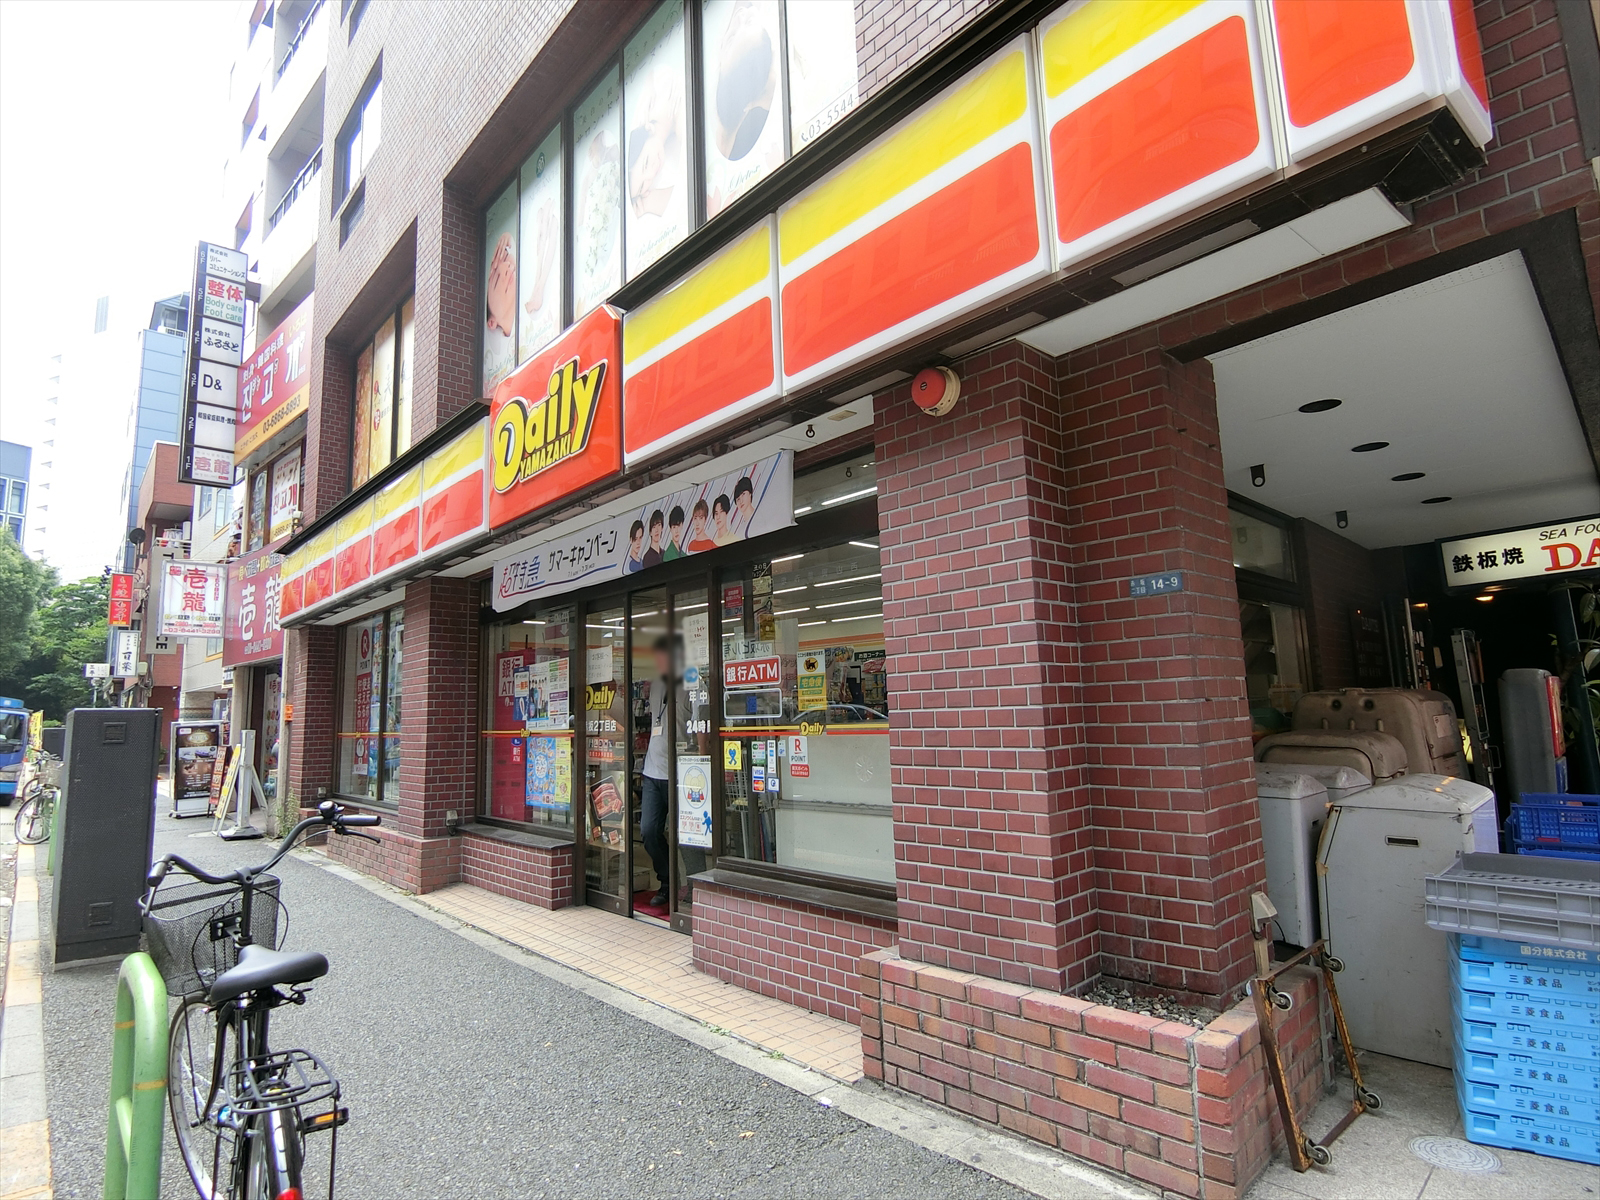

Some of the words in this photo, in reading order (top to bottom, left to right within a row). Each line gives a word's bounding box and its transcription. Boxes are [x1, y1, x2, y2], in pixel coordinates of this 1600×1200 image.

[207, 279, 244, 303] 整体
[205, 296, 225, 309] Body
[226, 303, 243, 314] care
[205, 306, 223, 318] Foot
[225, 312, 243, 323] care
[204, 336, 239, 353] ふるさと
[191, 373, 197, 387] 3F
[203, 373, 222, 391] D&
[188, 416, 195, 431] 2F
[494, 358, 607, 493] Daily
[186, 456, 191, 470] 1F
[520, 432, 573, 481] YAMAZAKI
[1538, 527, 1567, 541] SEA
[549, 530, 619, 572] サマーキャンペーン
[1452, 547, 1525, 573] 鉄板焼
[1151, 576, 1178, 590] 14-9
[726, 662, 778, 683] 銀行ATM
[501, 680, 514, 696] AT
[688, 690, 708, 703] 年中
[586, 685, 616, 710] Daily
[586, 720, 617, 732] 坂2丁目店
[800, 721, 824, 737] Daily
[1520, 945, 1588, 960] 国分株式会社
[1509, 974, 1562, 989] 三菱食品
[1511, 1005, 1565, 1020] 三菱食品
[1512, 1036, 1566, 1052] 三菱食品
[1514, 1067, 1568, 1084] 三菱食品
[1515, 1098, 1569, 1115] 三菱食品
[1515, 1129, 1570, 1147] 三菱食品
